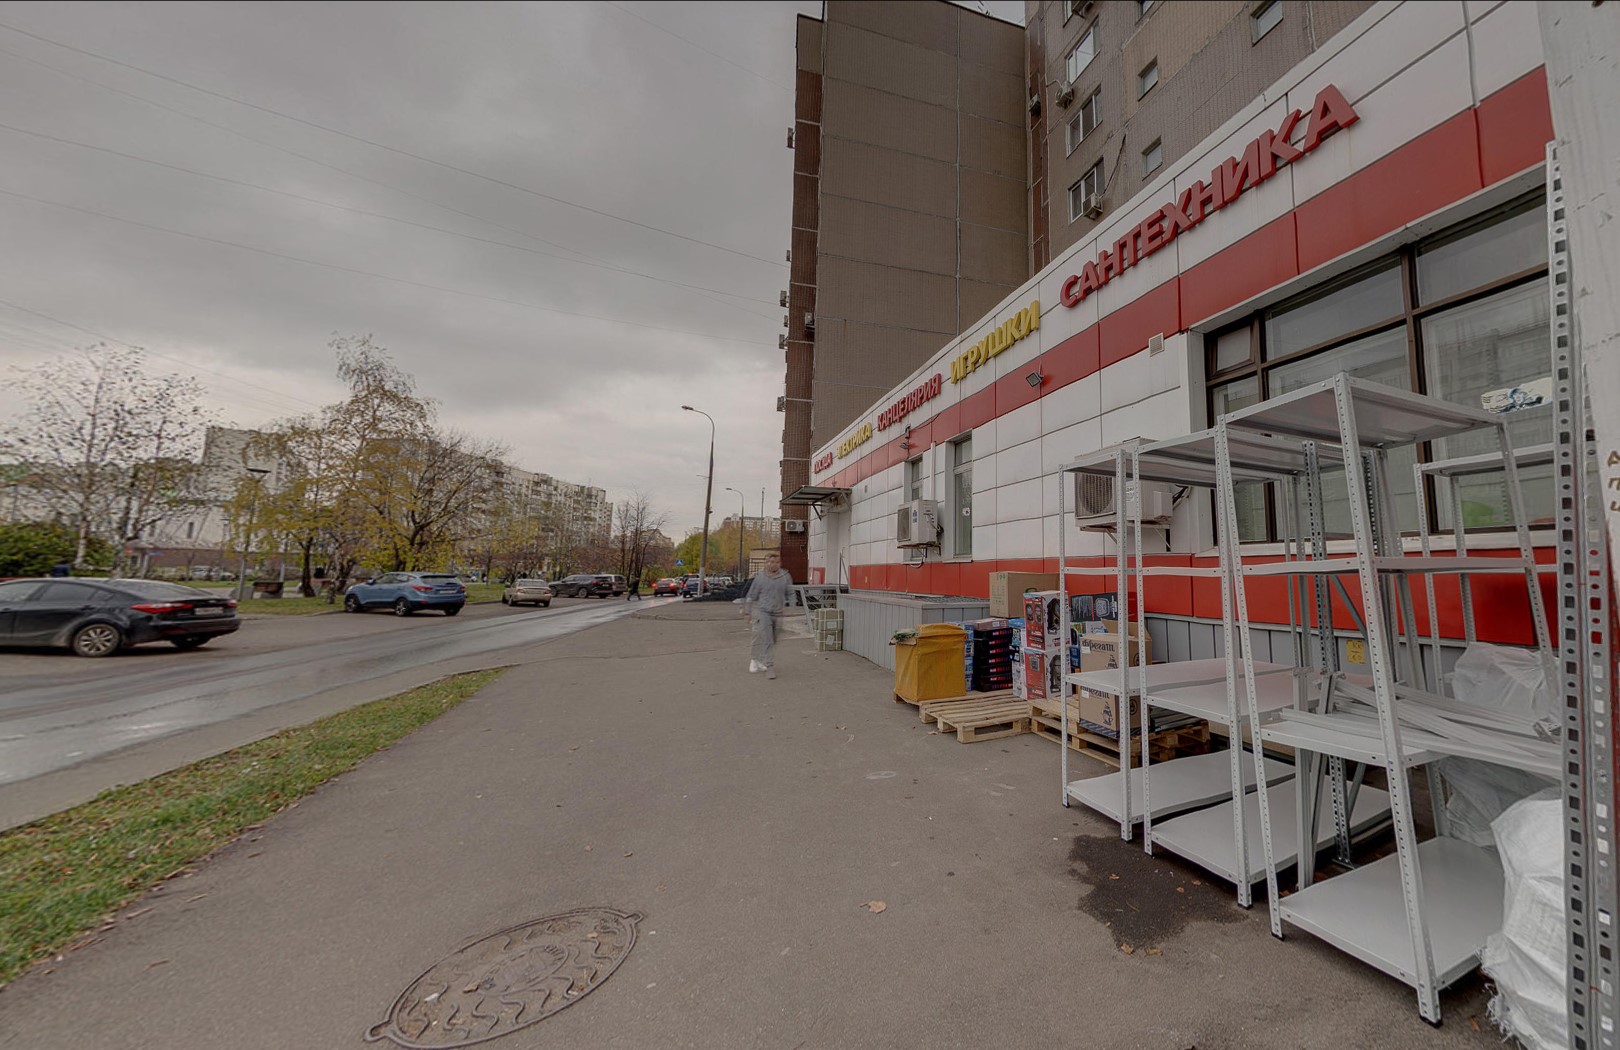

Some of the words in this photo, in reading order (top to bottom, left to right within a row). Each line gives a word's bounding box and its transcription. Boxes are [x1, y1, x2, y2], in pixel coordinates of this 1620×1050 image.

[1060, 83, 1360, 308] САНТЕХНИКА
[950, 300, 1040, 384] ИГРУШКИ
[877, 373, 942, 432] КАНЦЕЛЯРИЯ
